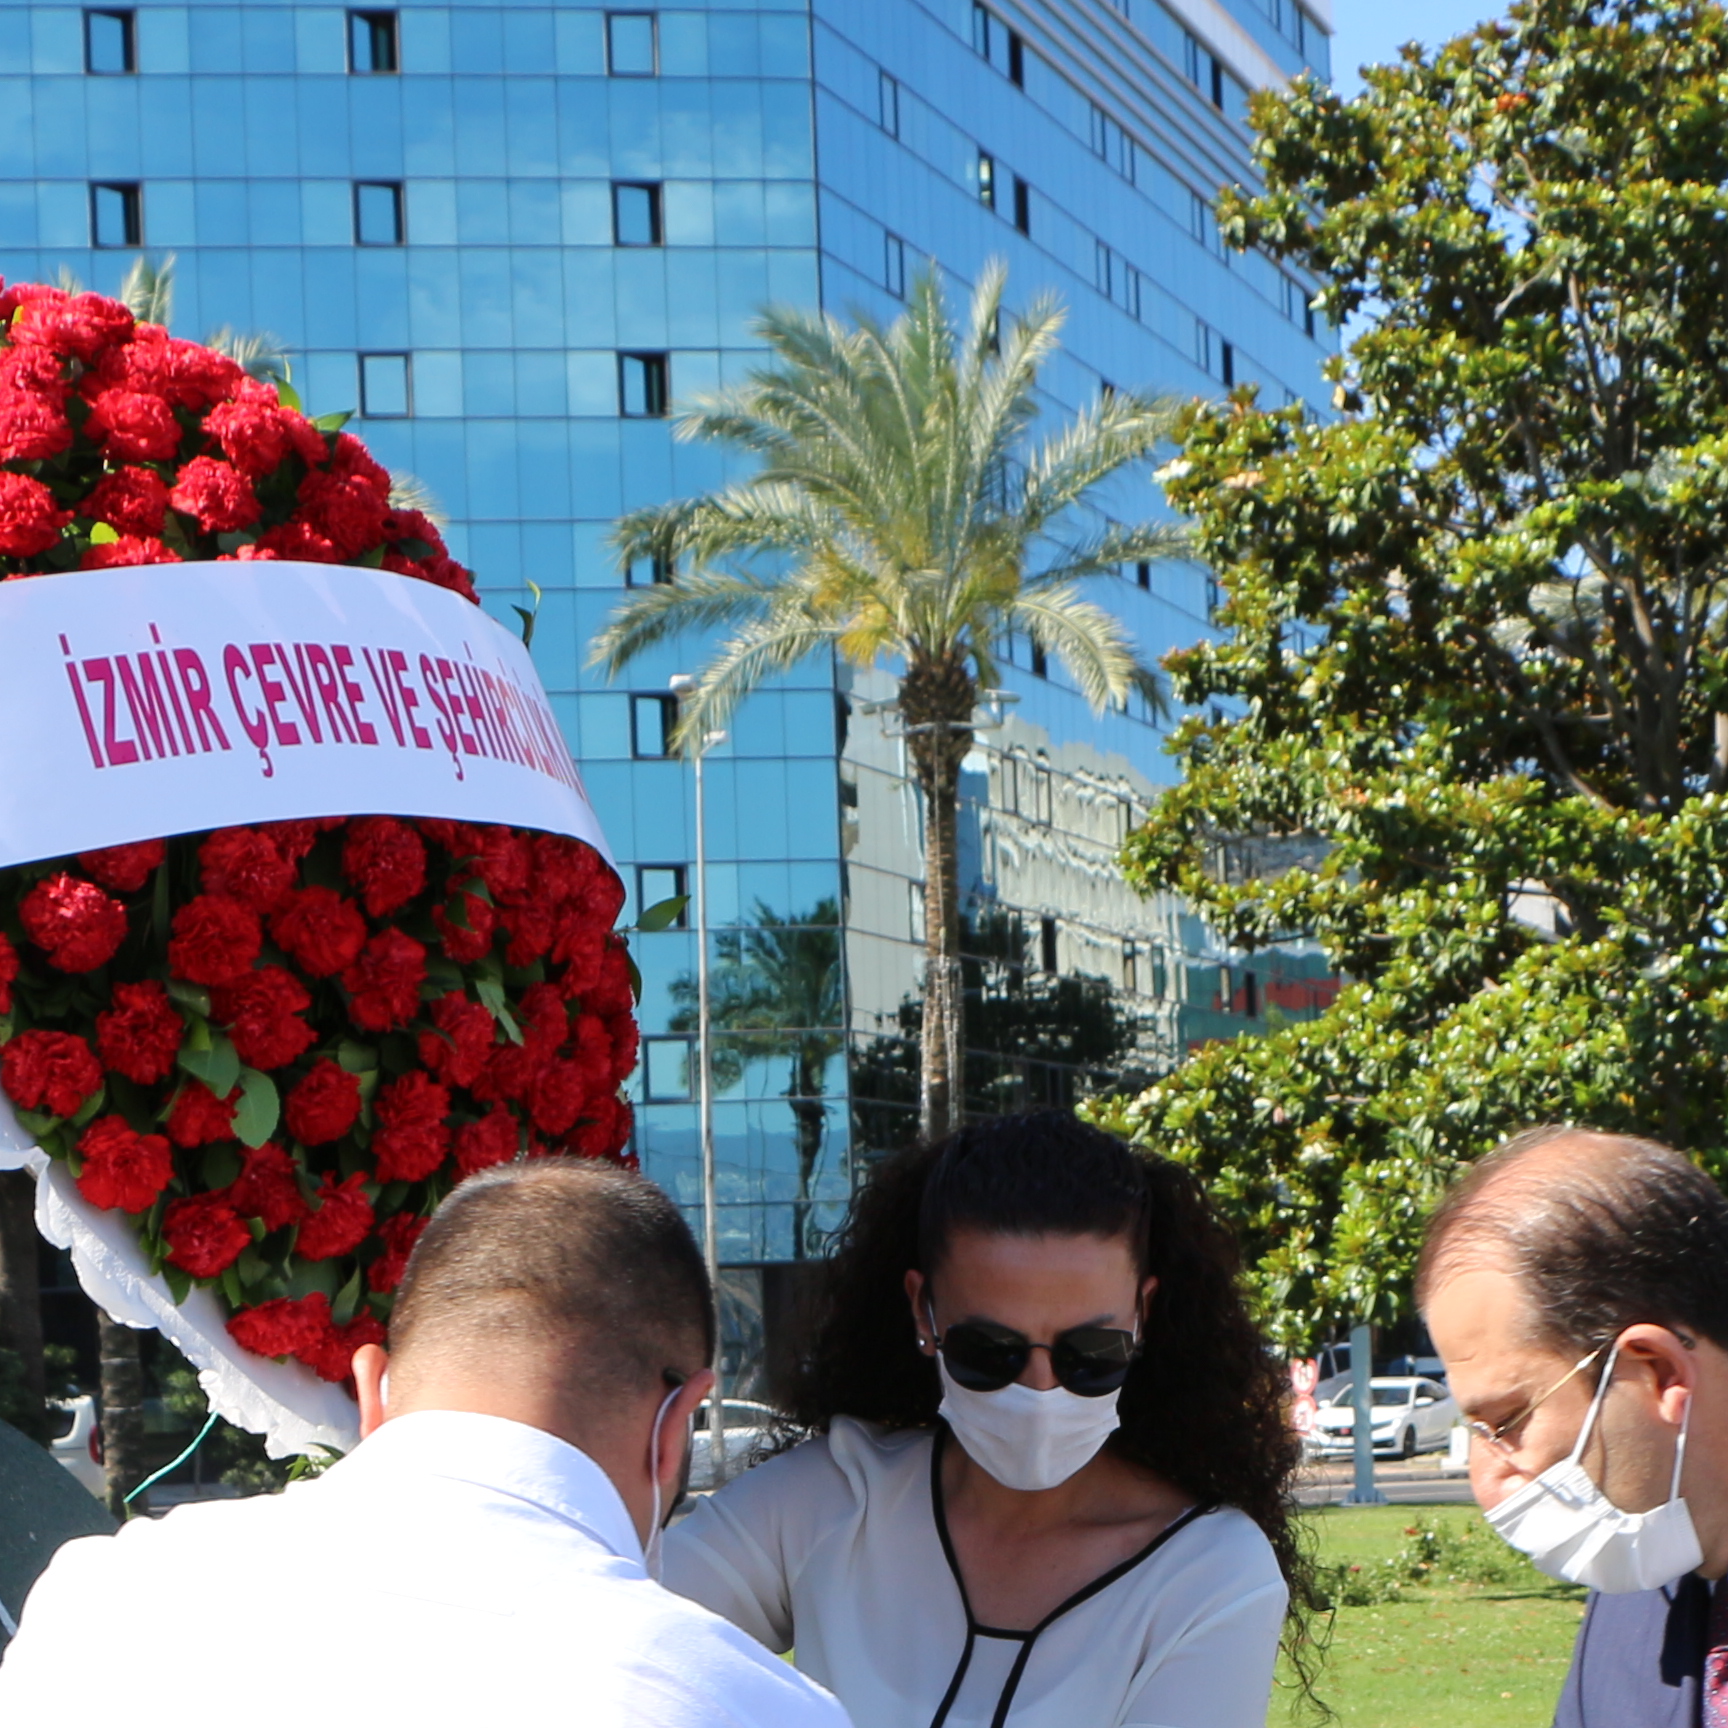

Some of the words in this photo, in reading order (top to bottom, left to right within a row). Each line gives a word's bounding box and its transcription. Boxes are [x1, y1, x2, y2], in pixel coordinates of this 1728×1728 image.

[58, 622, 231, 769] İZMİR
[223, 642, 378, 778] ÇEVRE
[361, 646, 433, 750] VE
